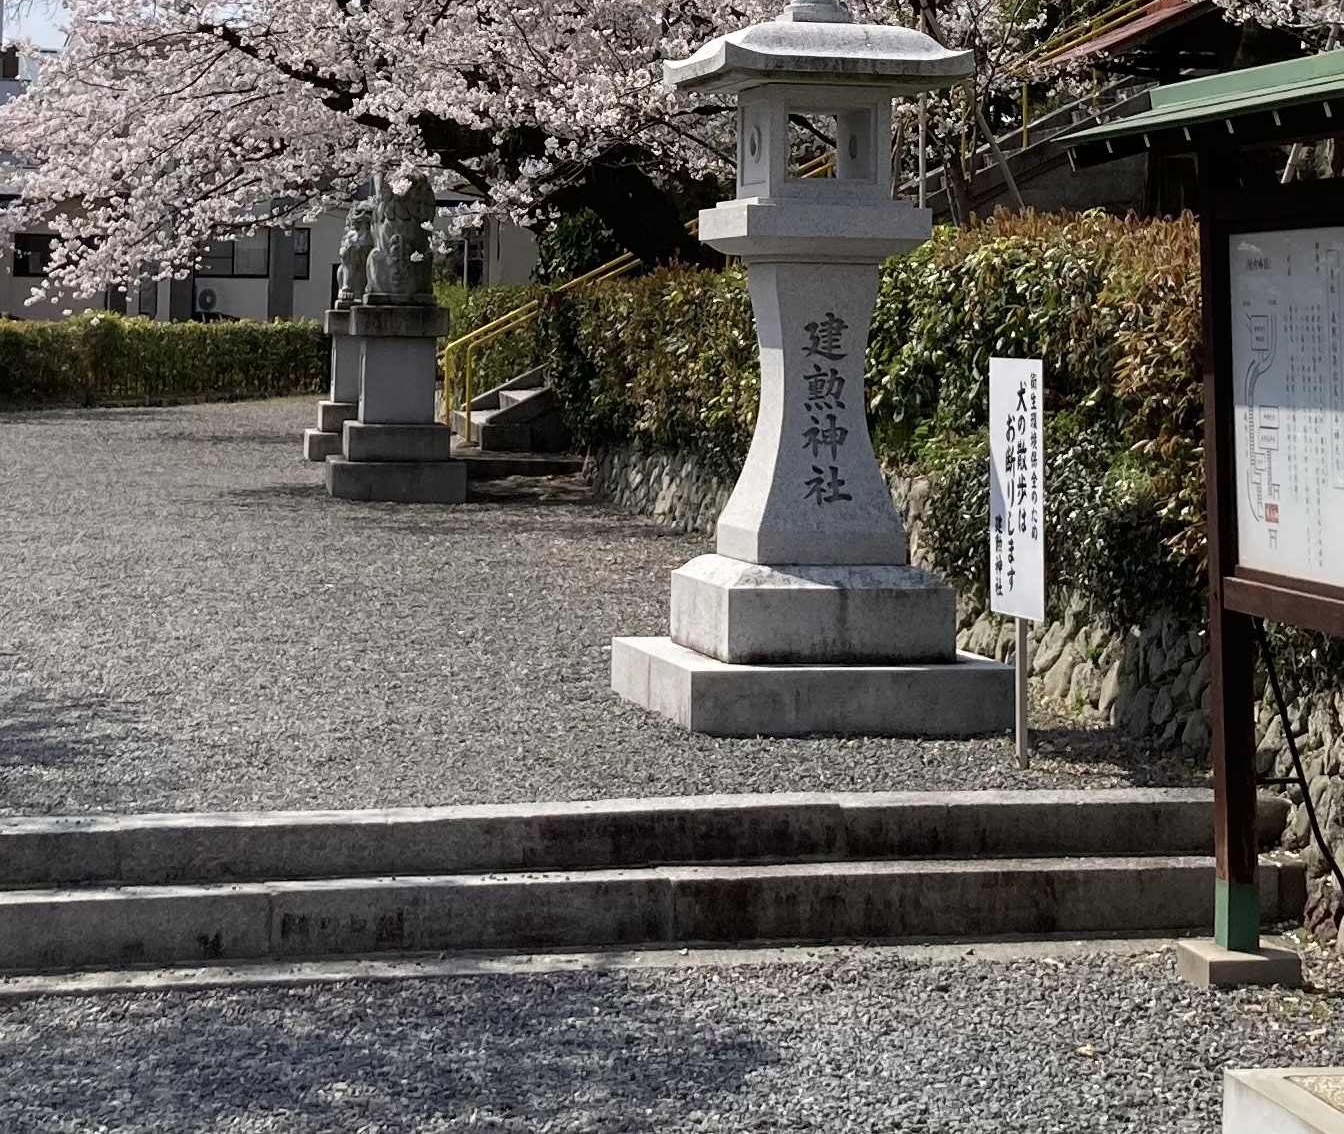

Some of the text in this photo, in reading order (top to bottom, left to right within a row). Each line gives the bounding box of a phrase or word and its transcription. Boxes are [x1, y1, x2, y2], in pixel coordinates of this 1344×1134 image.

[801, 312, 853, 506] 建勲神社
[1016, 380, 1028, 534] 犬の散歩は
[1005, 413, 1016, 593] お断りします
